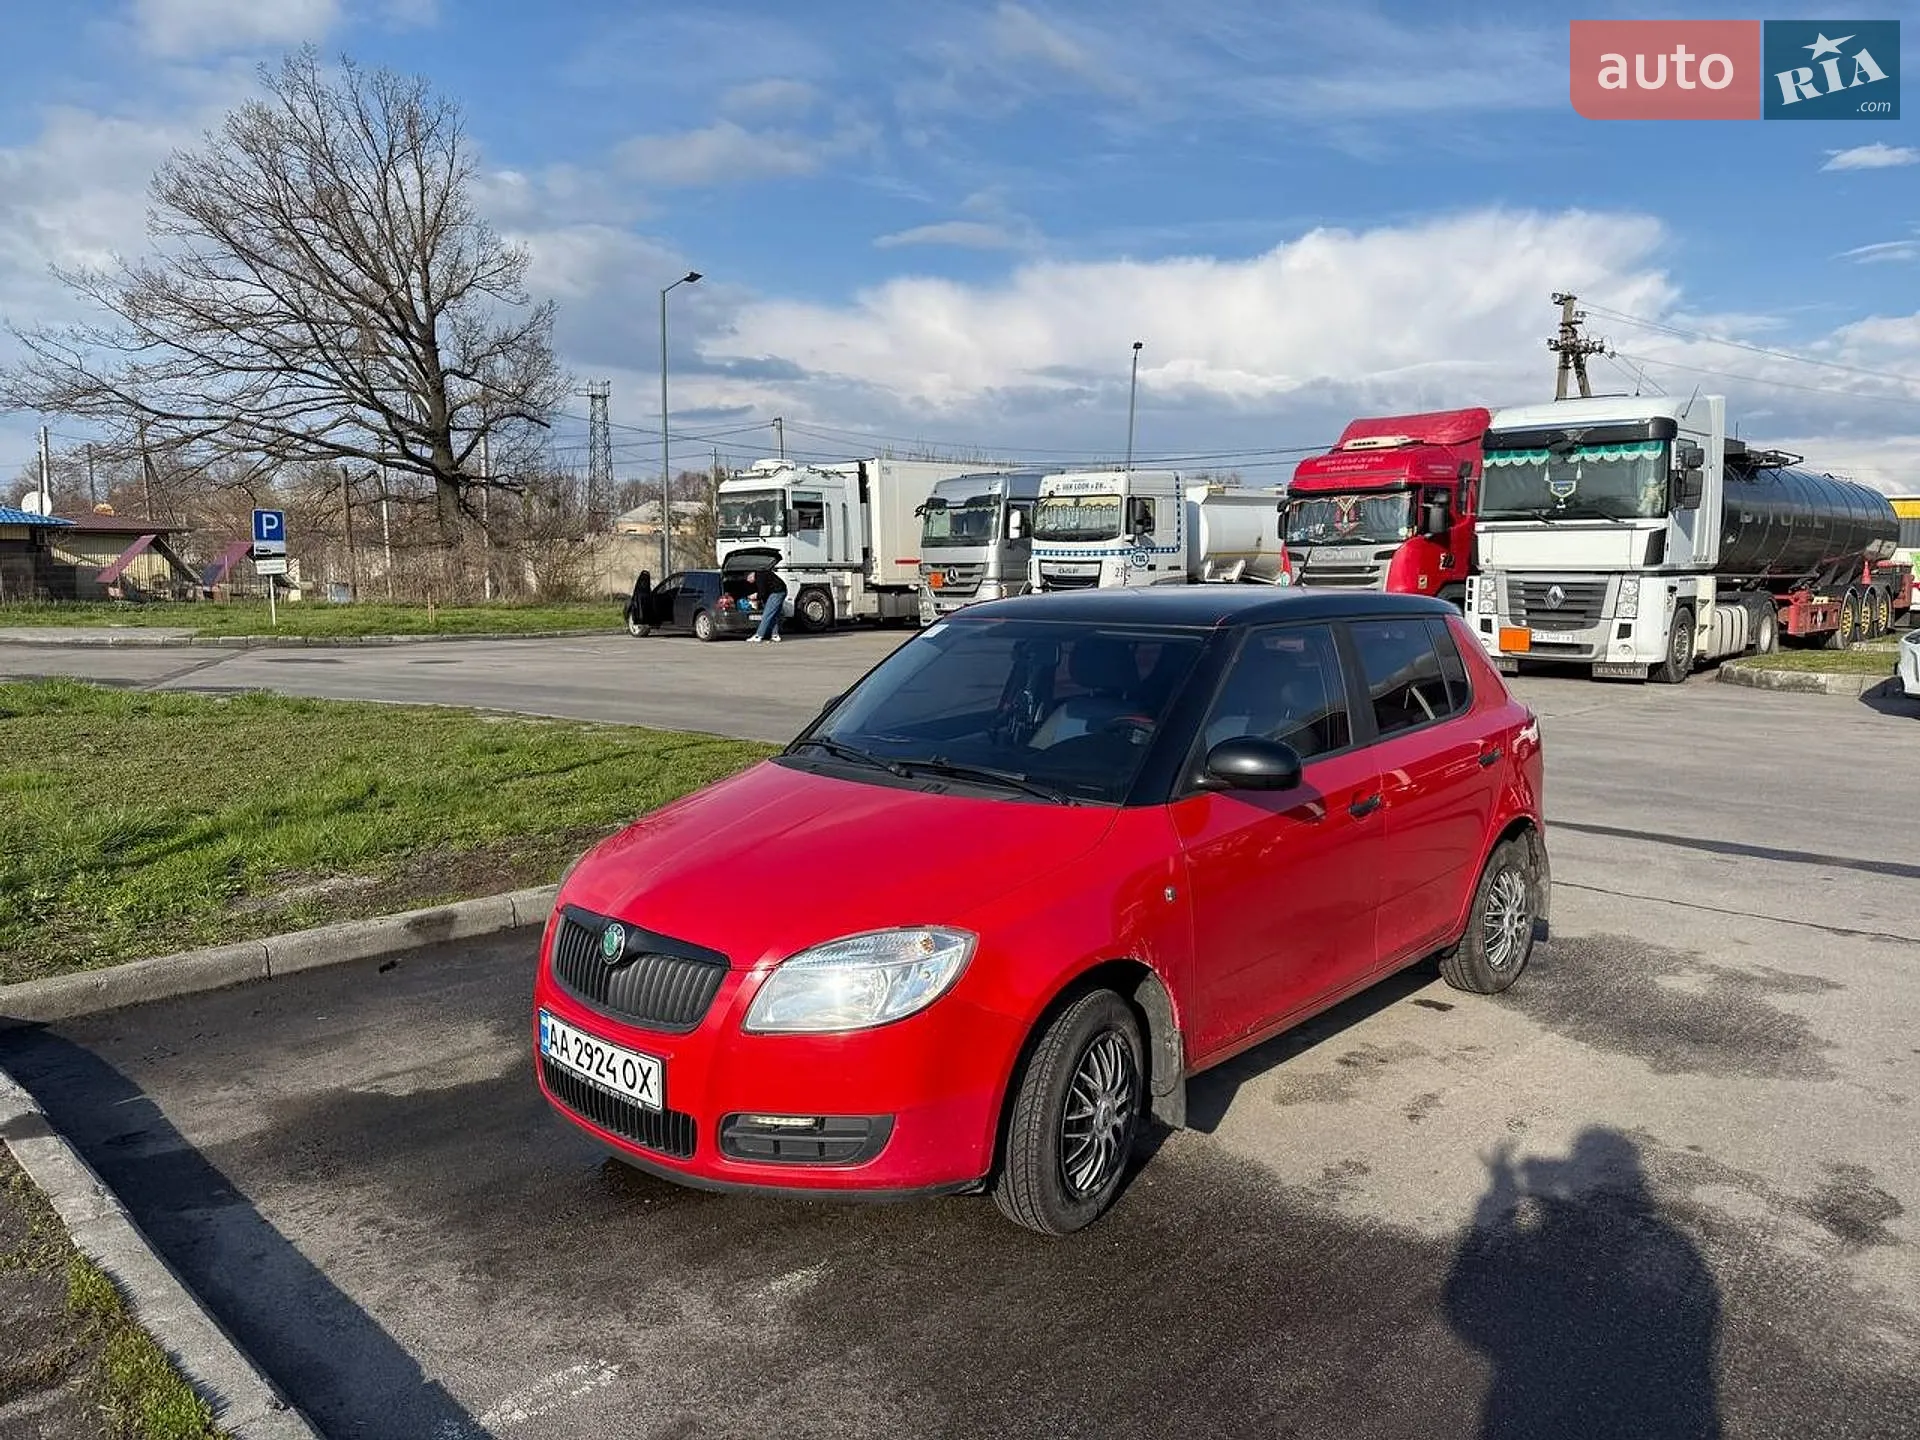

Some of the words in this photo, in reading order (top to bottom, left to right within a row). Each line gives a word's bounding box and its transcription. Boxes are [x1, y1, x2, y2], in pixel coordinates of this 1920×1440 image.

[262, 513, 279, 538] P
[550, 1023, 571, 1062] AA
[574, 1036, 618, 1084] 2924
[622, 1058, 653, 1099] OX
